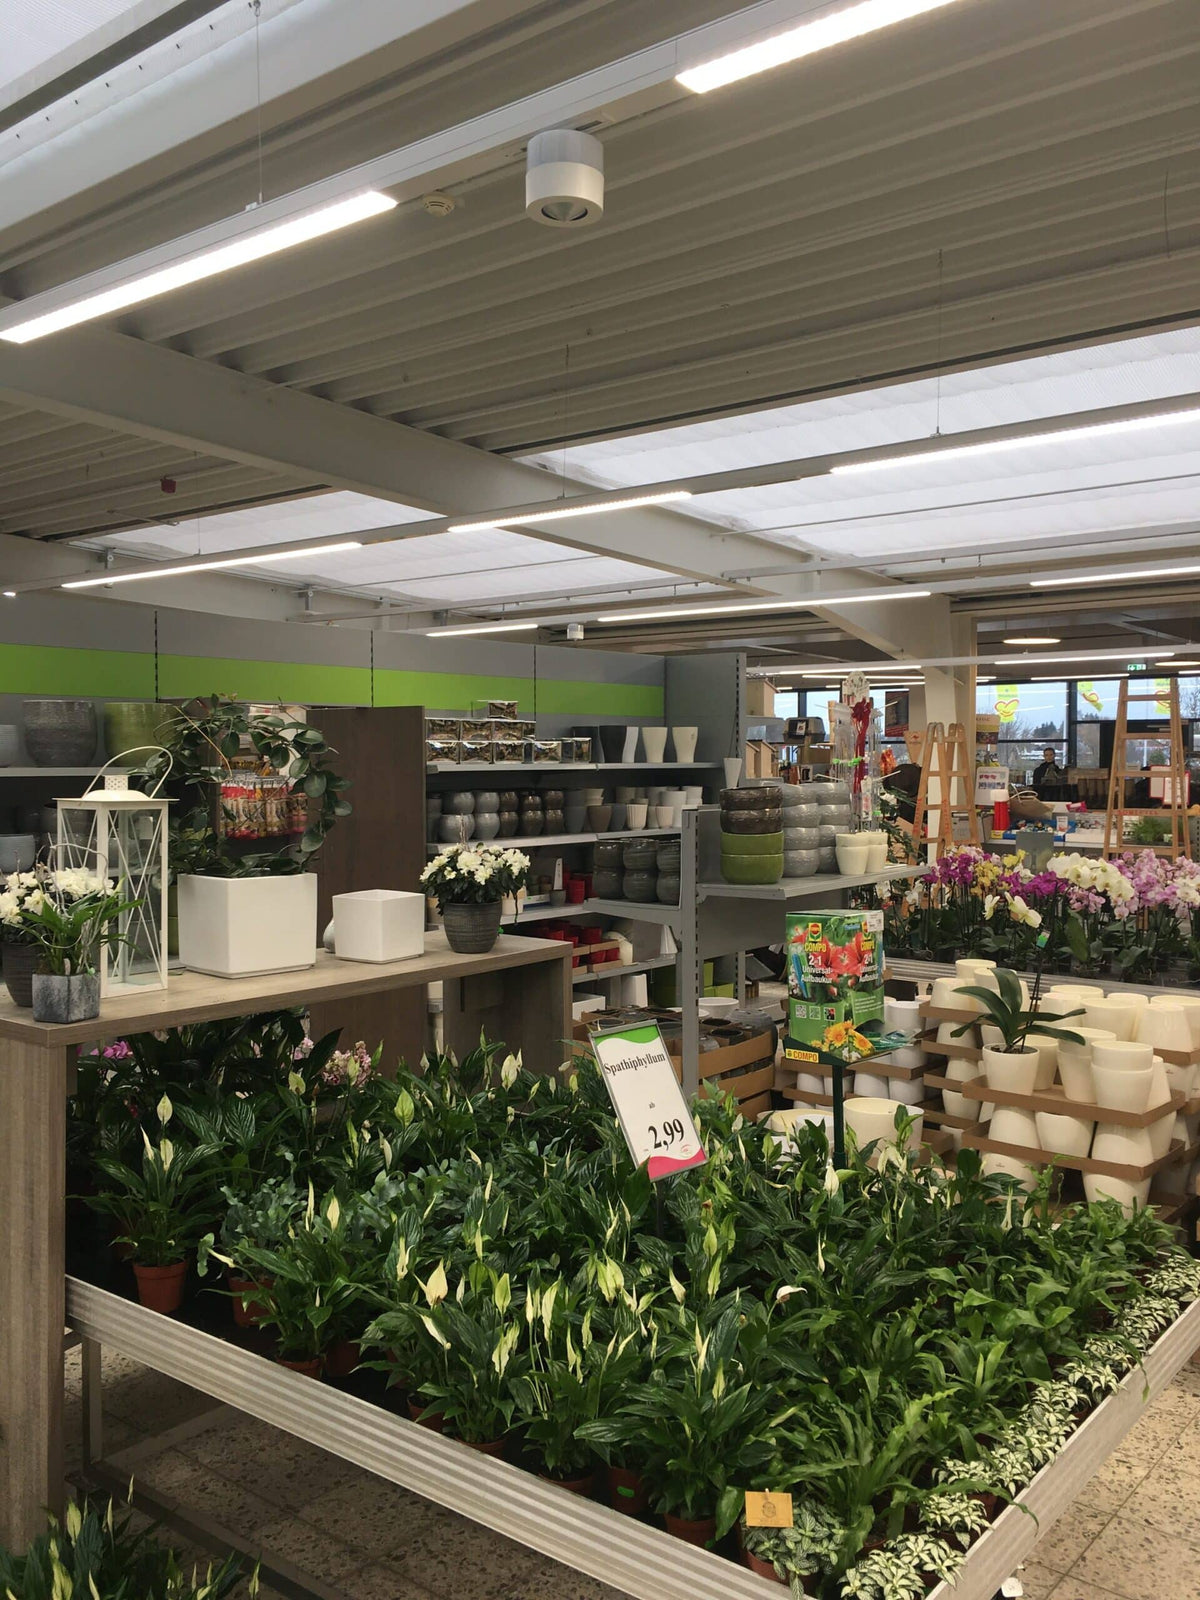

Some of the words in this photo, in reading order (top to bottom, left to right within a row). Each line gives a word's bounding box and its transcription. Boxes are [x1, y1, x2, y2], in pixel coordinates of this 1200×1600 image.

[804, 942, 827, 953] COMPO
[604, 1052, 665, 1075] Spathiphyllum
[793, 1050, 818, 1062] COMPO
[648, 1118, 685, 1152] 2,99
